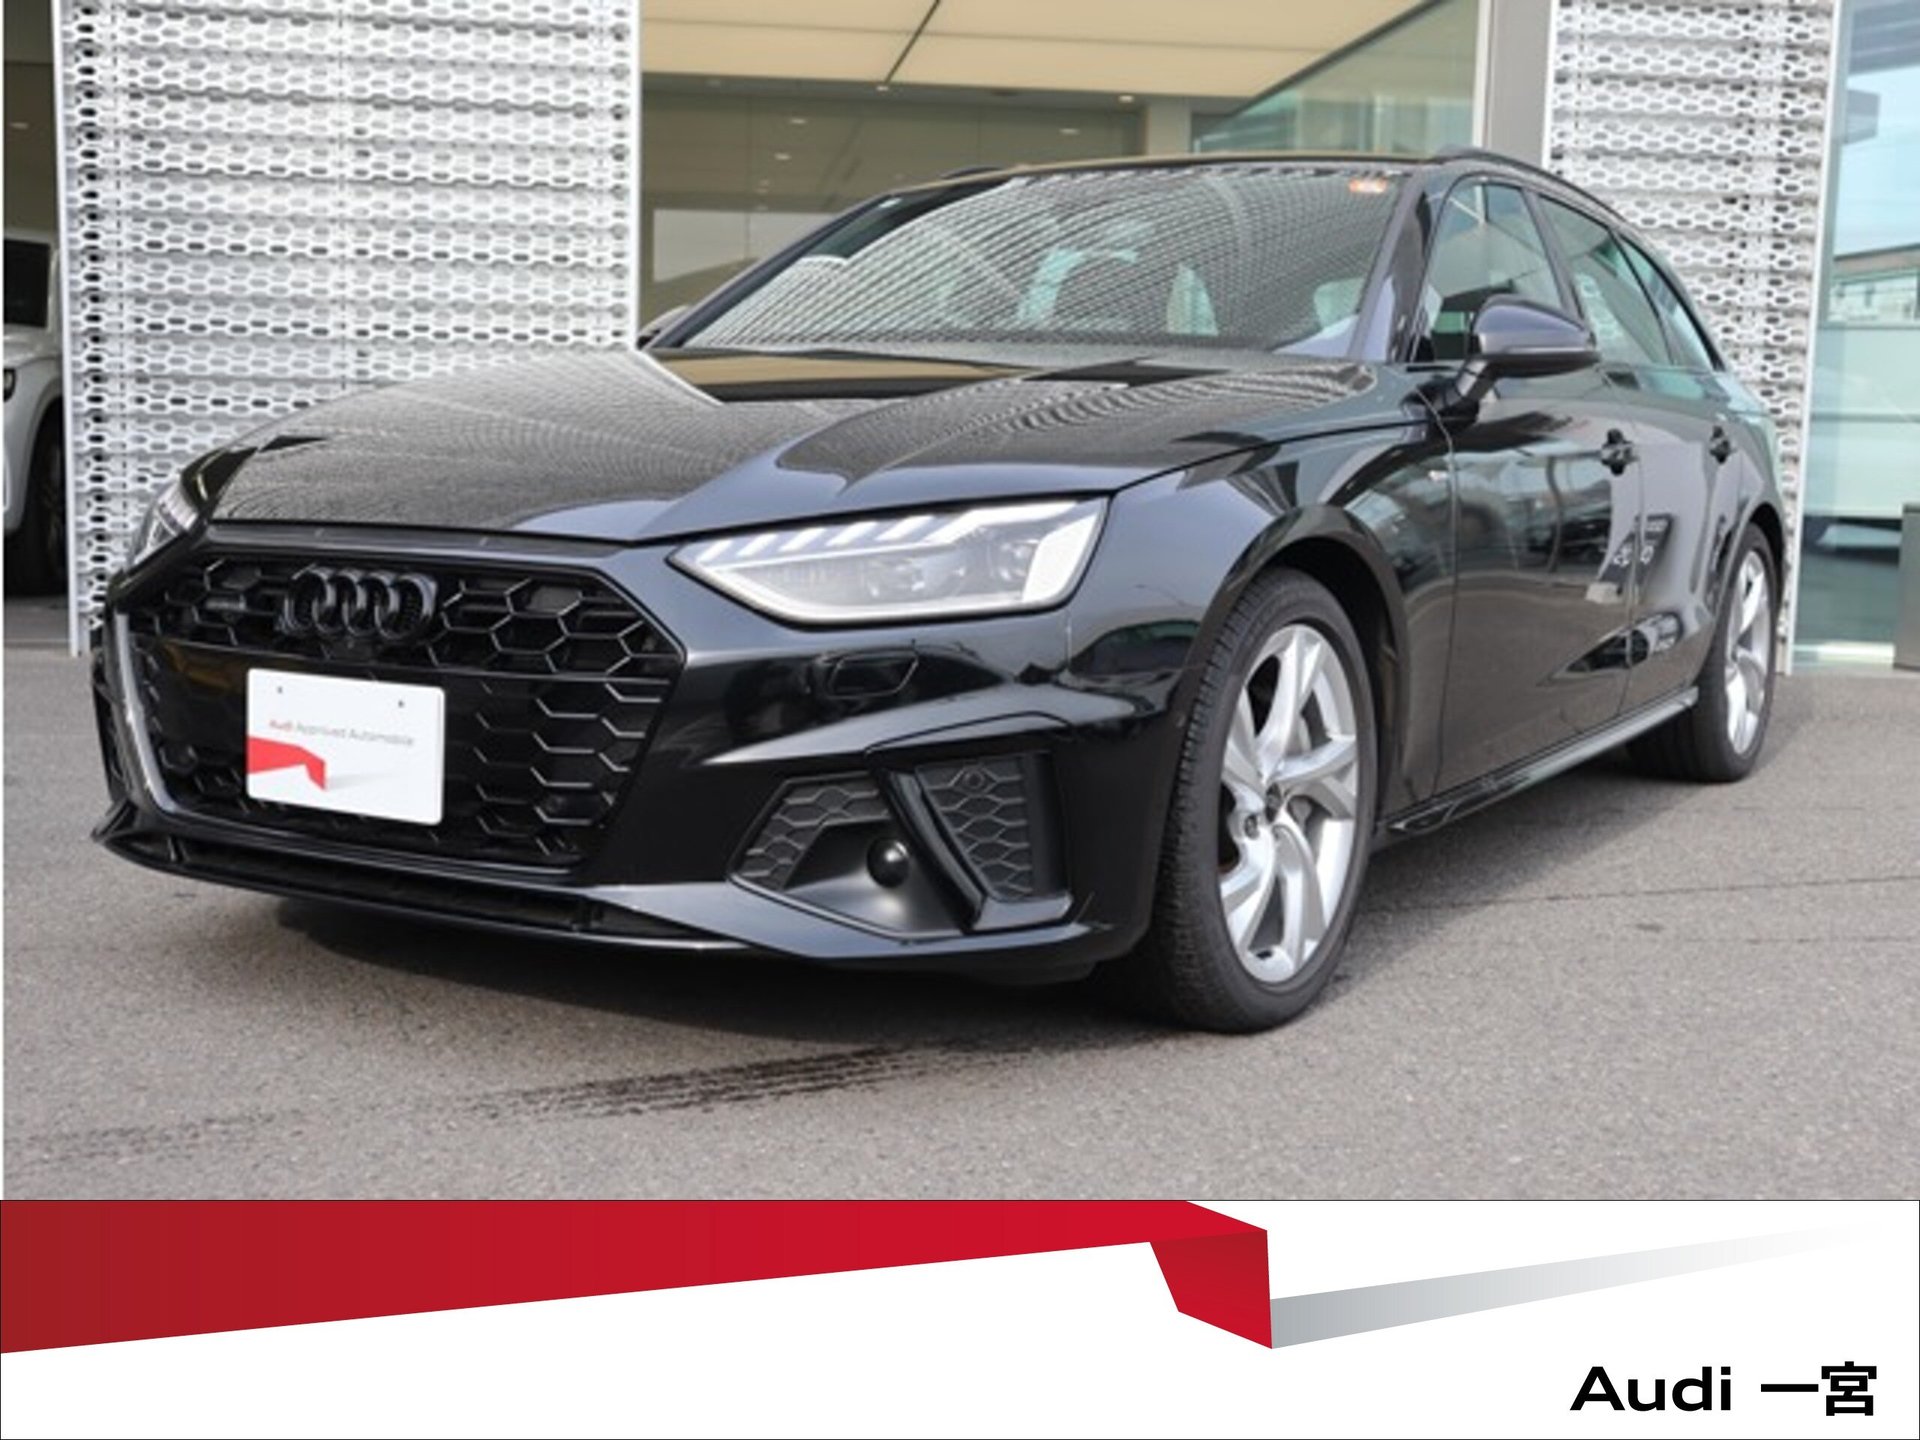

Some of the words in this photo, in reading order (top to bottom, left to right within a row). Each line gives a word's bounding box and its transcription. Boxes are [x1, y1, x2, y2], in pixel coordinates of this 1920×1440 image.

[269, 719, 293, 732] Audi
[296, 721, 346, 739] Approved
[349, 727, 415, 747] Automobile
